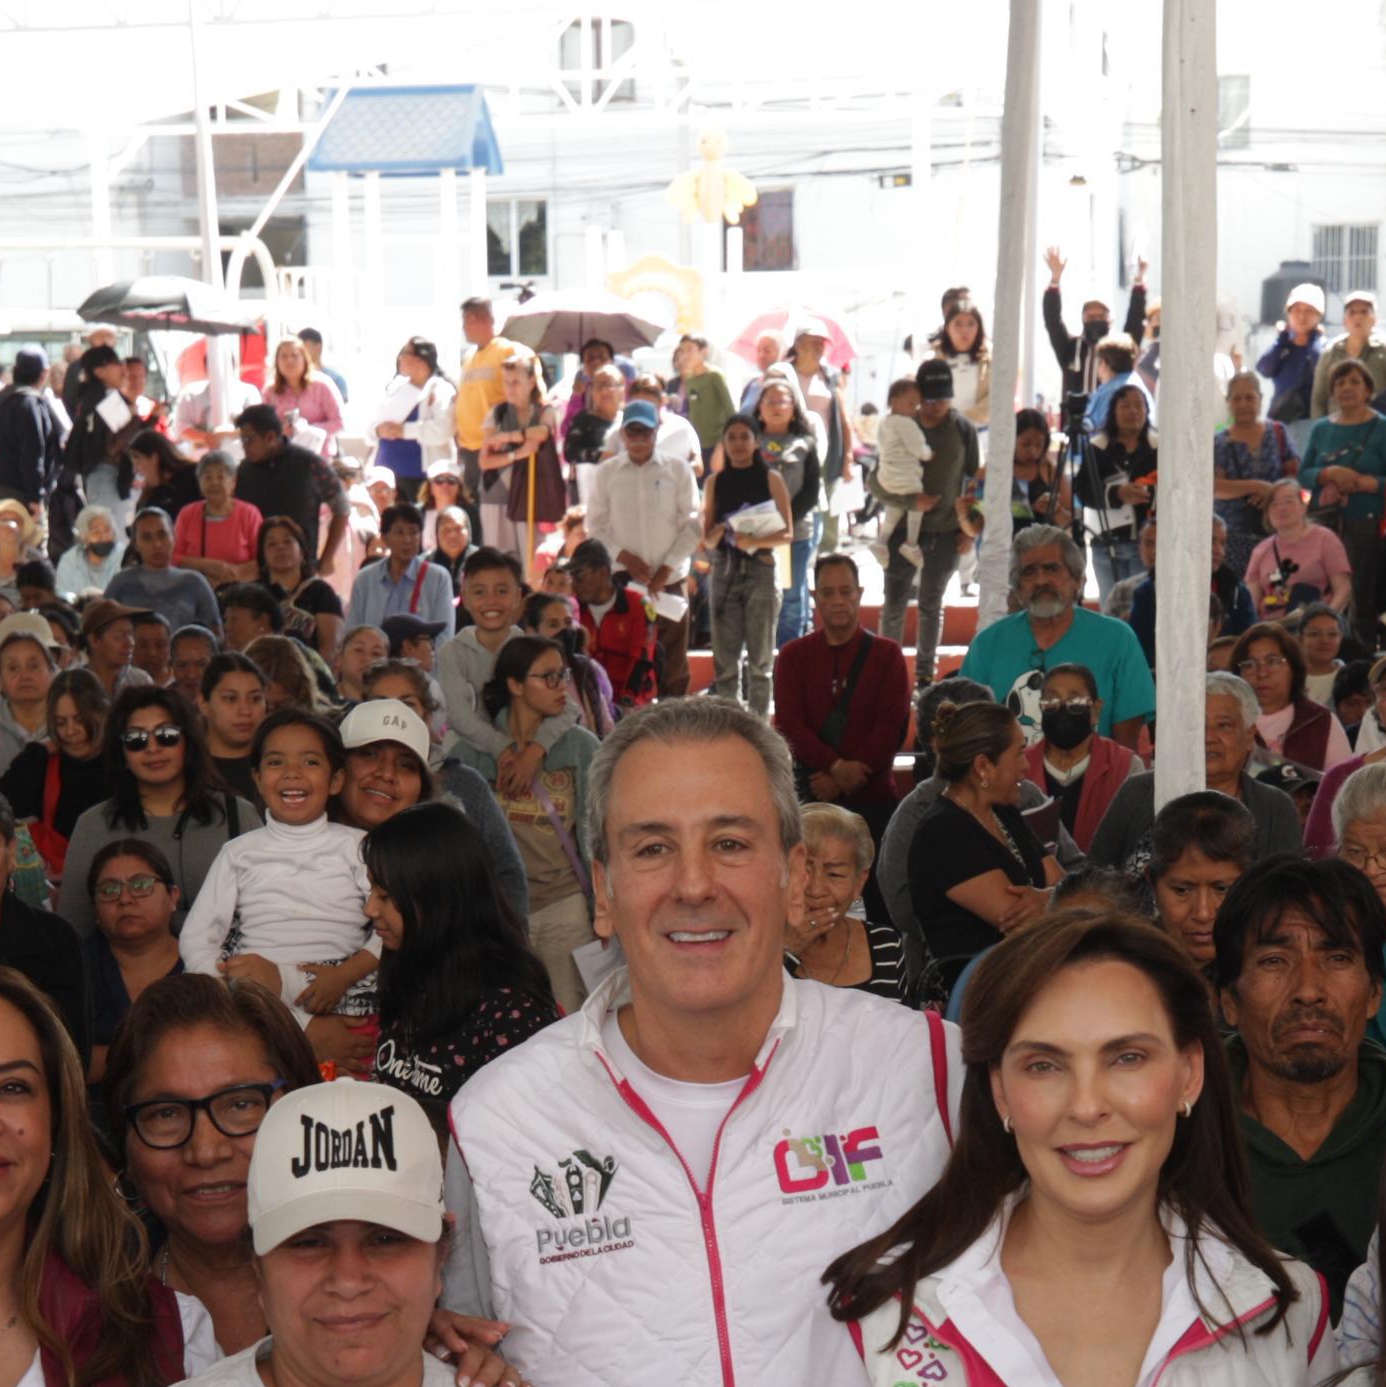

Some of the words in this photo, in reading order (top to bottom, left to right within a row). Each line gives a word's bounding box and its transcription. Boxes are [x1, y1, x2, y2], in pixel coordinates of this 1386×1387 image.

[382, 715, 407, 730] GAP
[291, 1104, 397, 1179] JORDAN
[773, 1127, 883, 1194] DIF
[819, 1187, 861, 1201] MUNICIPAL
[862, 1179, 894, 1192] PUEBLA
[536, 1216, 632, 1253] Puebla
[539, 1251, 580, 1265] GOBIERNO
[603, 1240, 635, 1253] CIUDAD
